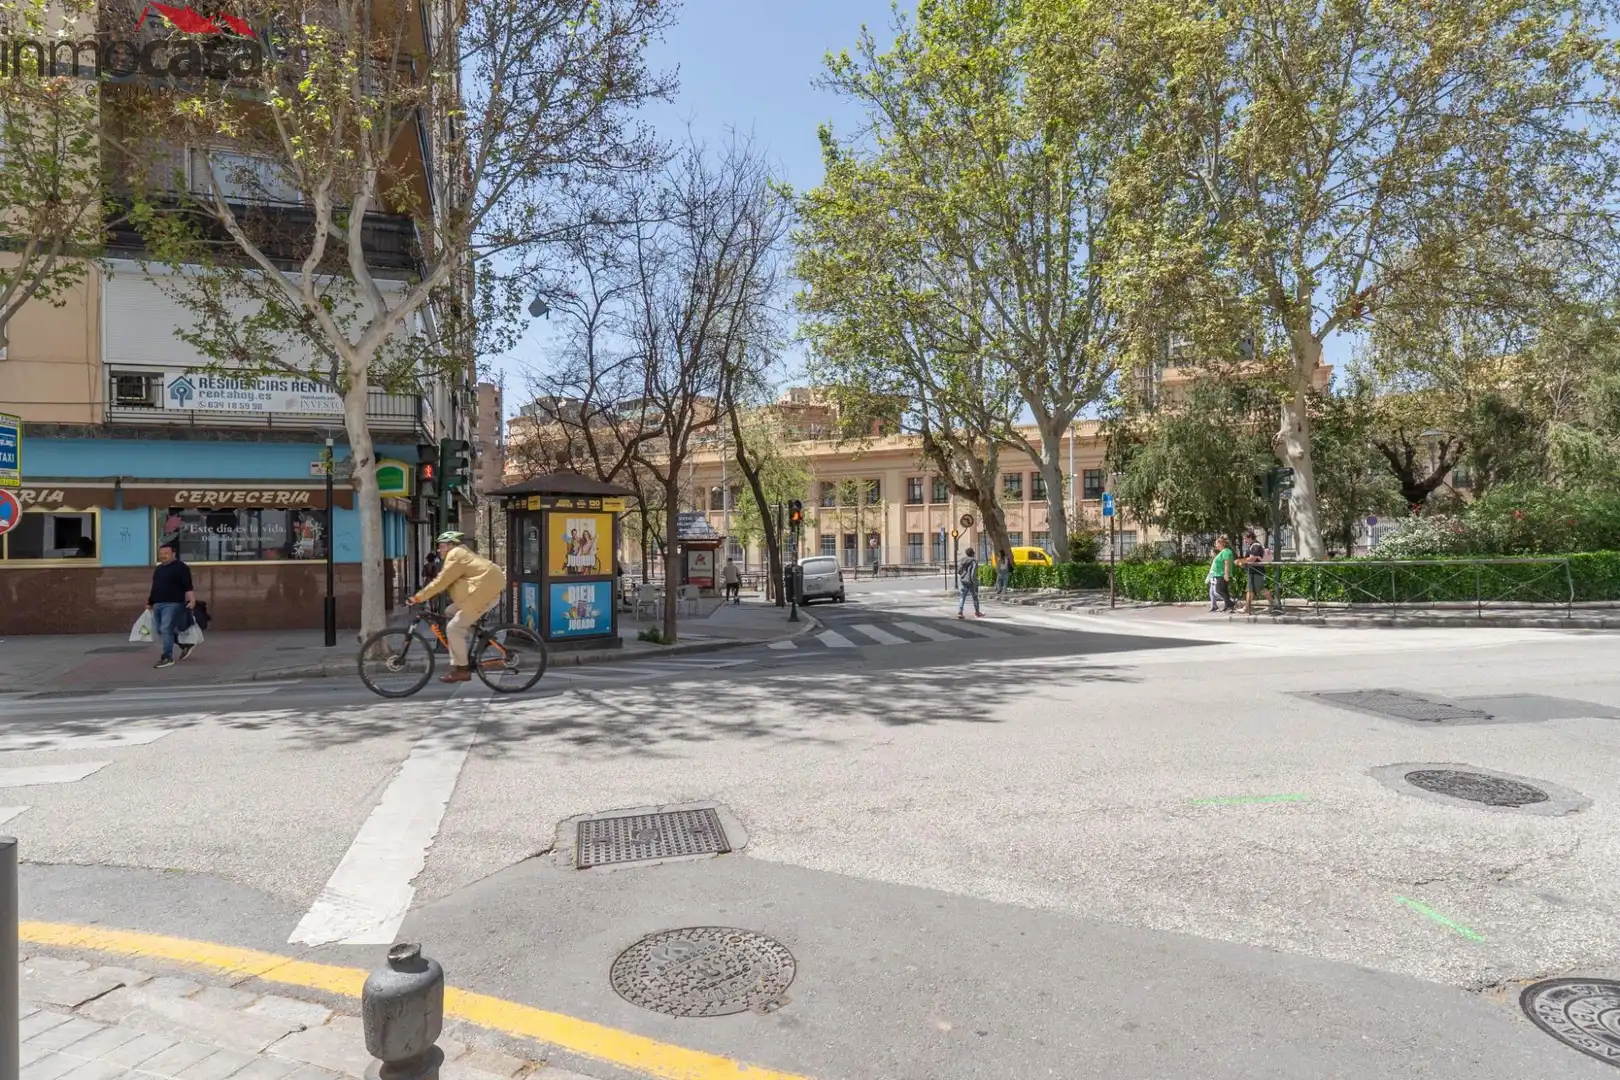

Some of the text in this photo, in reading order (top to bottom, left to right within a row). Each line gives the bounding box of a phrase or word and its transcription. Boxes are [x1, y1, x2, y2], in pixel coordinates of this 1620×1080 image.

[198, 376, 288, 393] RESIDENCIAS
[198, 389, 272, 402] rentahoy.es
[207, 401, 225, 409] 634
[239, 402, 250, 410] 59
[251, 403, 263, 411] 98
[174, 489, 311, 505] CERVECERIA
[190, 522, 287, 534] Este día es la vida.
[567, 584, 596, 604] BIEN
[567, 618, 596, 631] JUGADO
